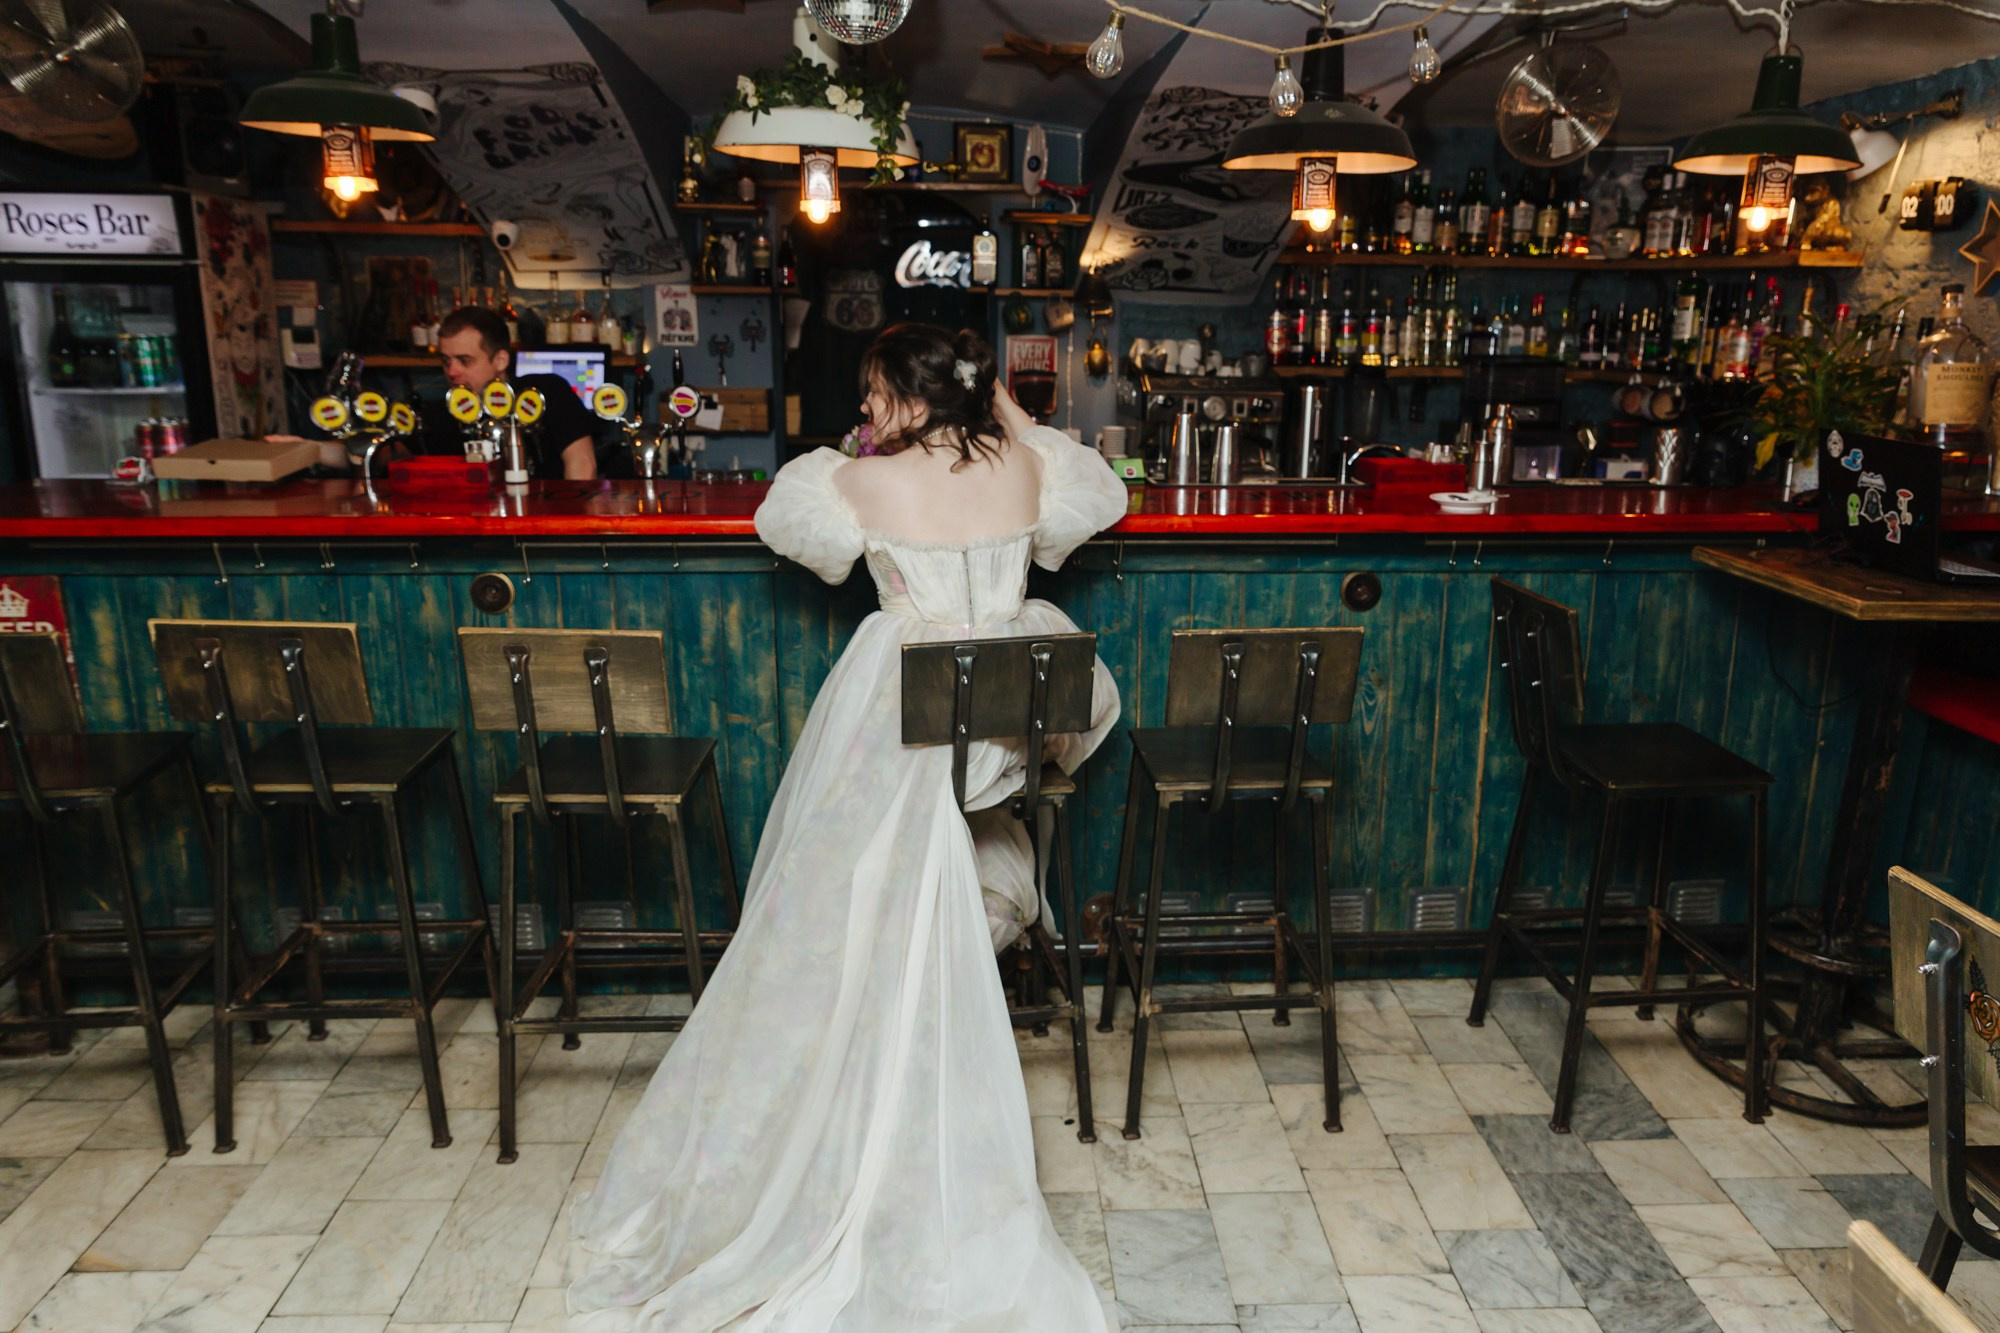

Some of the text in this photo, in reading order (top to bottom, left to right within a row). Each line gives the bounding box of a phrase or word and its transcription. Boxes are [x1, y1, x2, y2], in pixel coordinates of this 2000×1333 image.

[1901, 193, 1955, 218] 02 00
[2, 202, 151, 237] Roses Bar
[1131, 236, 1200, 250] Rock
[1014, 342, 1052, 359] EVERY
